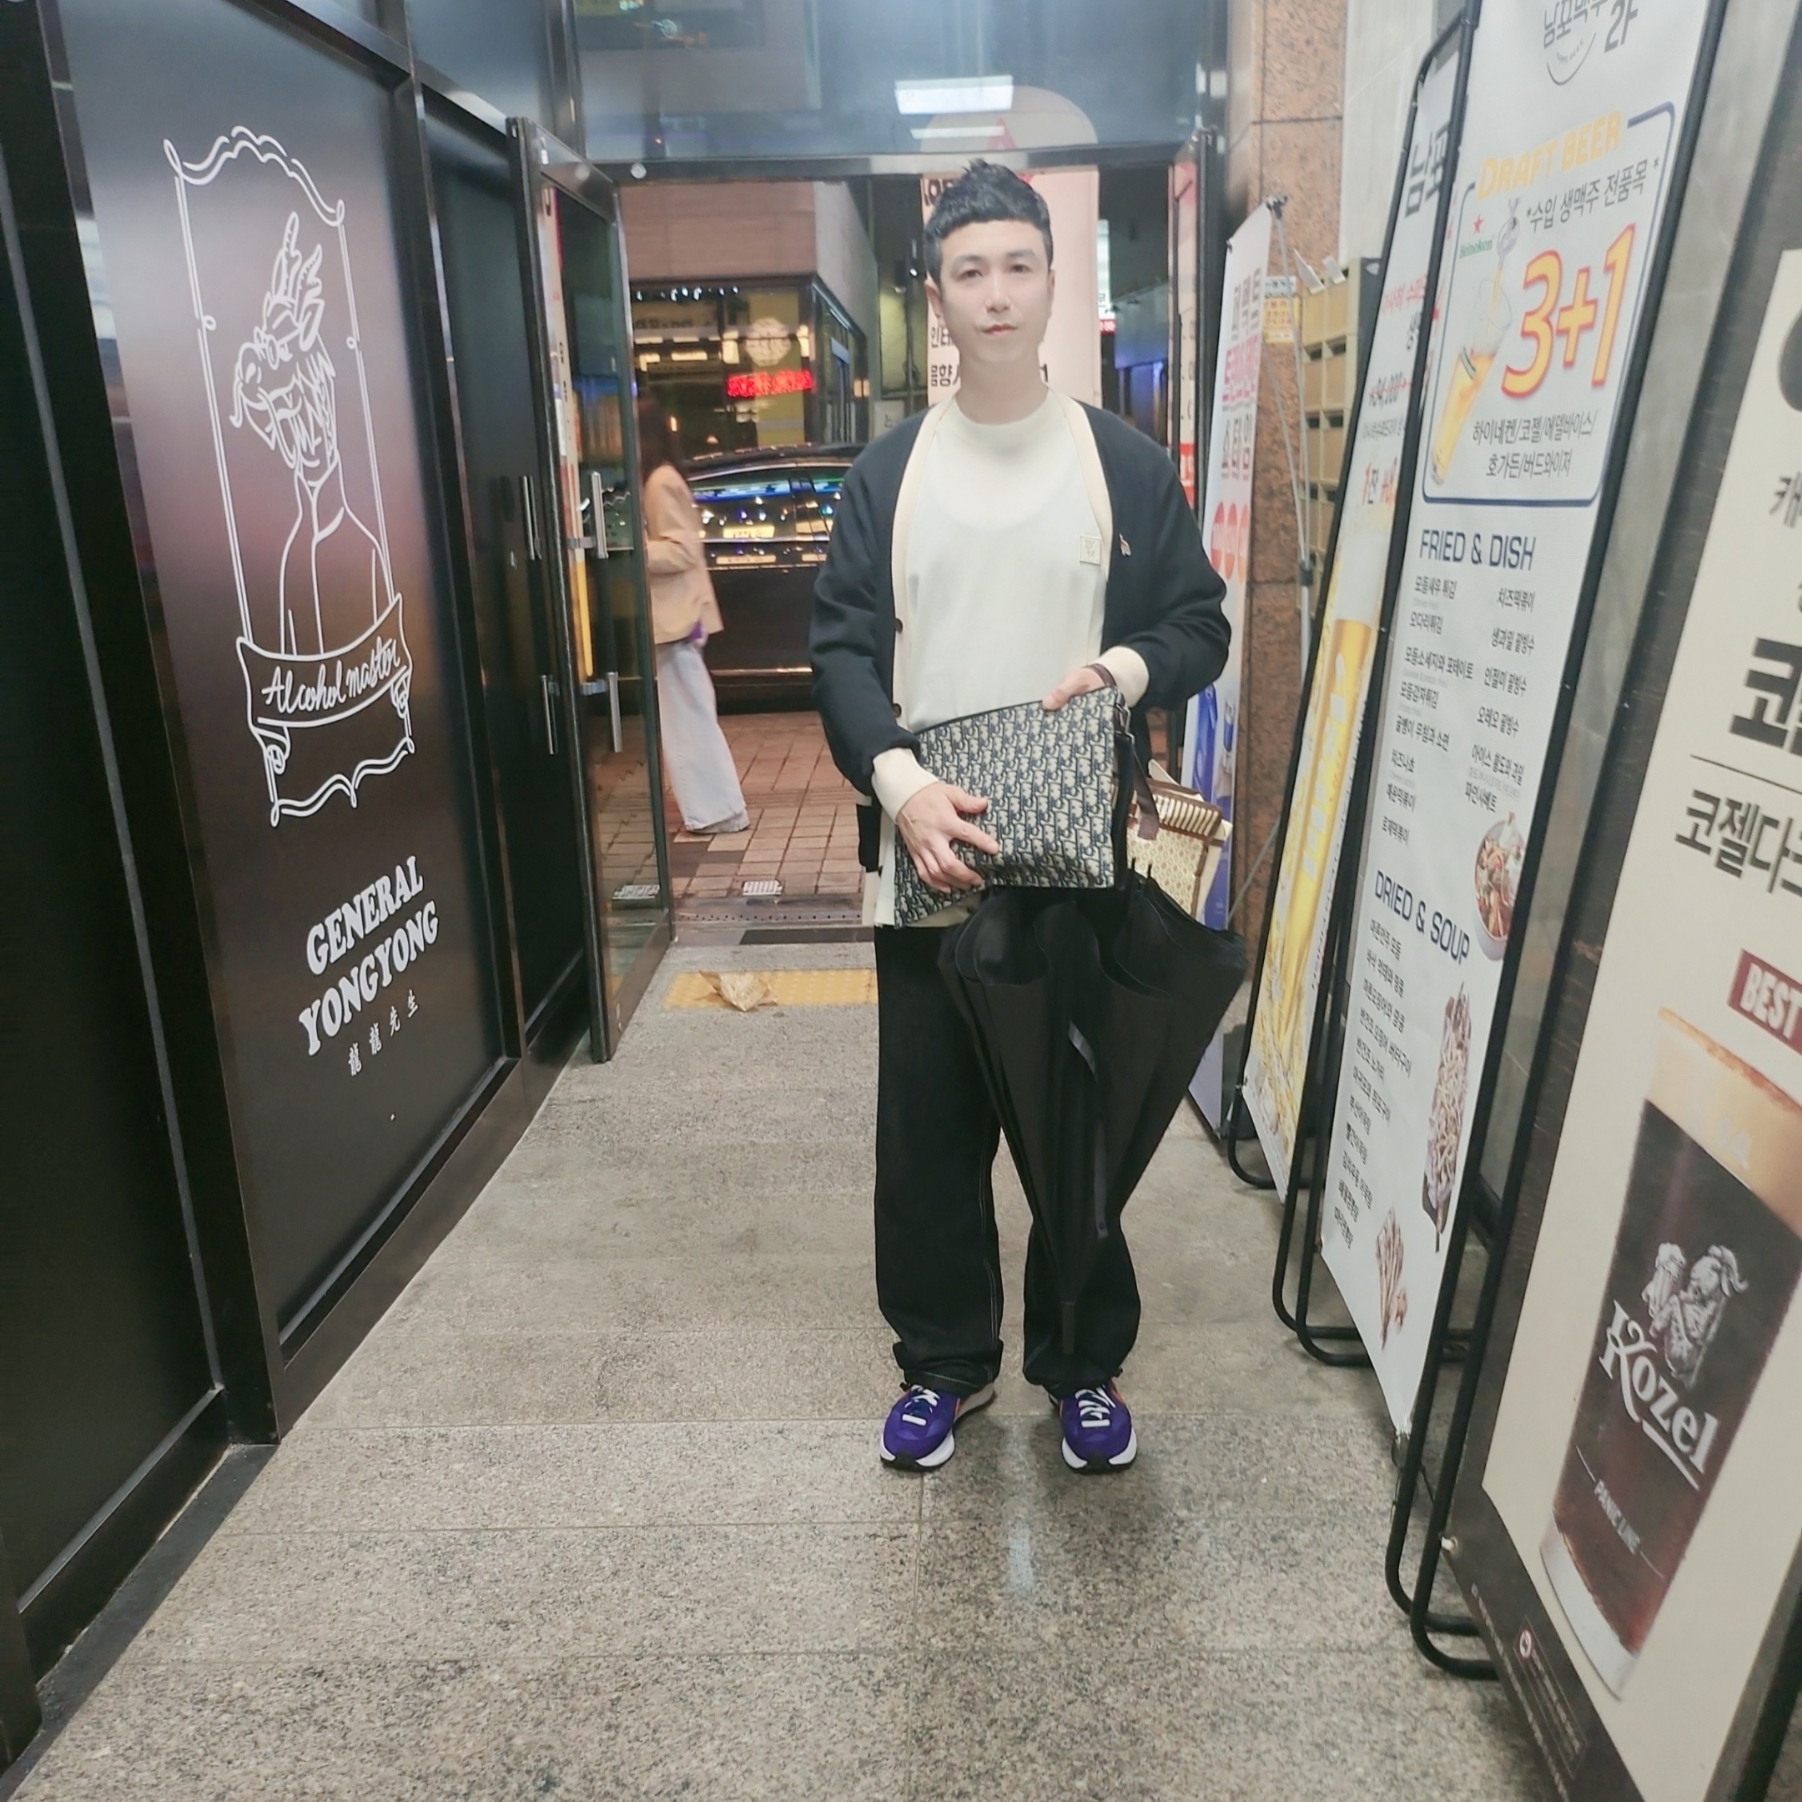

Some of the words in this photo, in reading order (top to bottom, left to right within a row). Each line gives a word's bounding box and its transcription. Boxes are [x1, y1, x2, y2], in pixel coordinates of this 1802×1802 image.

[1478, 140, 1557, 201] DRAFT
[1560, 110, 1621, 171] BEER
[1560, 179, 1601, 223] 생맥주
[1604, 158, 1648, 207] 전품목
[1459, 238, 1493, 259] Heineken
[1501, 222, 1636, 398] 3+1
[1419, 529, 1466, 563] FRIED
[1471, 532, 1482, 566] &
[1489, 534, 1536, 571] DISH
[1675, 789, 1802, 897] 코젤다
[306, 855, 424, 976] GENERAL
[1374, 870, 1413, 921] DRIED
[1416, 900, 1426, 935] &
[1430, 911, 1470, 965] SOUP
[299, 900, 438, 1056] YONGYONG
[1740, 962, 1802, 1040] BEST
[1599, 1299, 1719, 1475] Kozel
